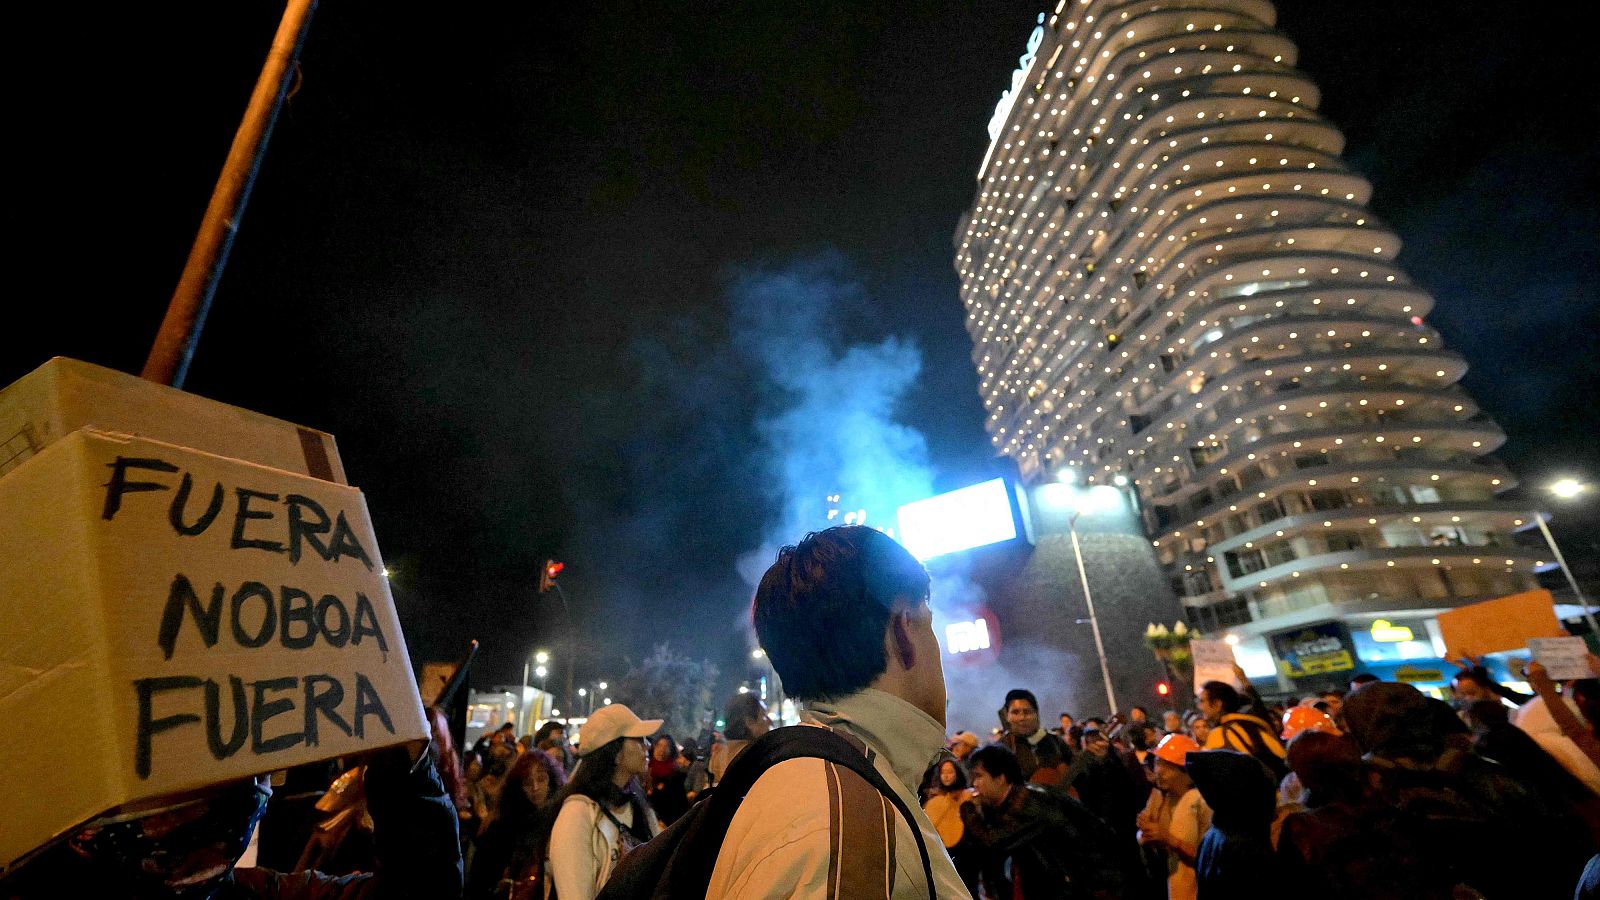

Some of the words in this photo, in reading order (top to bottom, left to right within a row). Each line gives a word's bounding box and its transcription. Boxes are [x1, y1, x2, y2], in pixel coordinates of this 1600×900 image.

[101, 455, 374, 571] FUERA
[157, 574, 389, 663] NOBOA
[133, 671, 395, 779] FUERA
